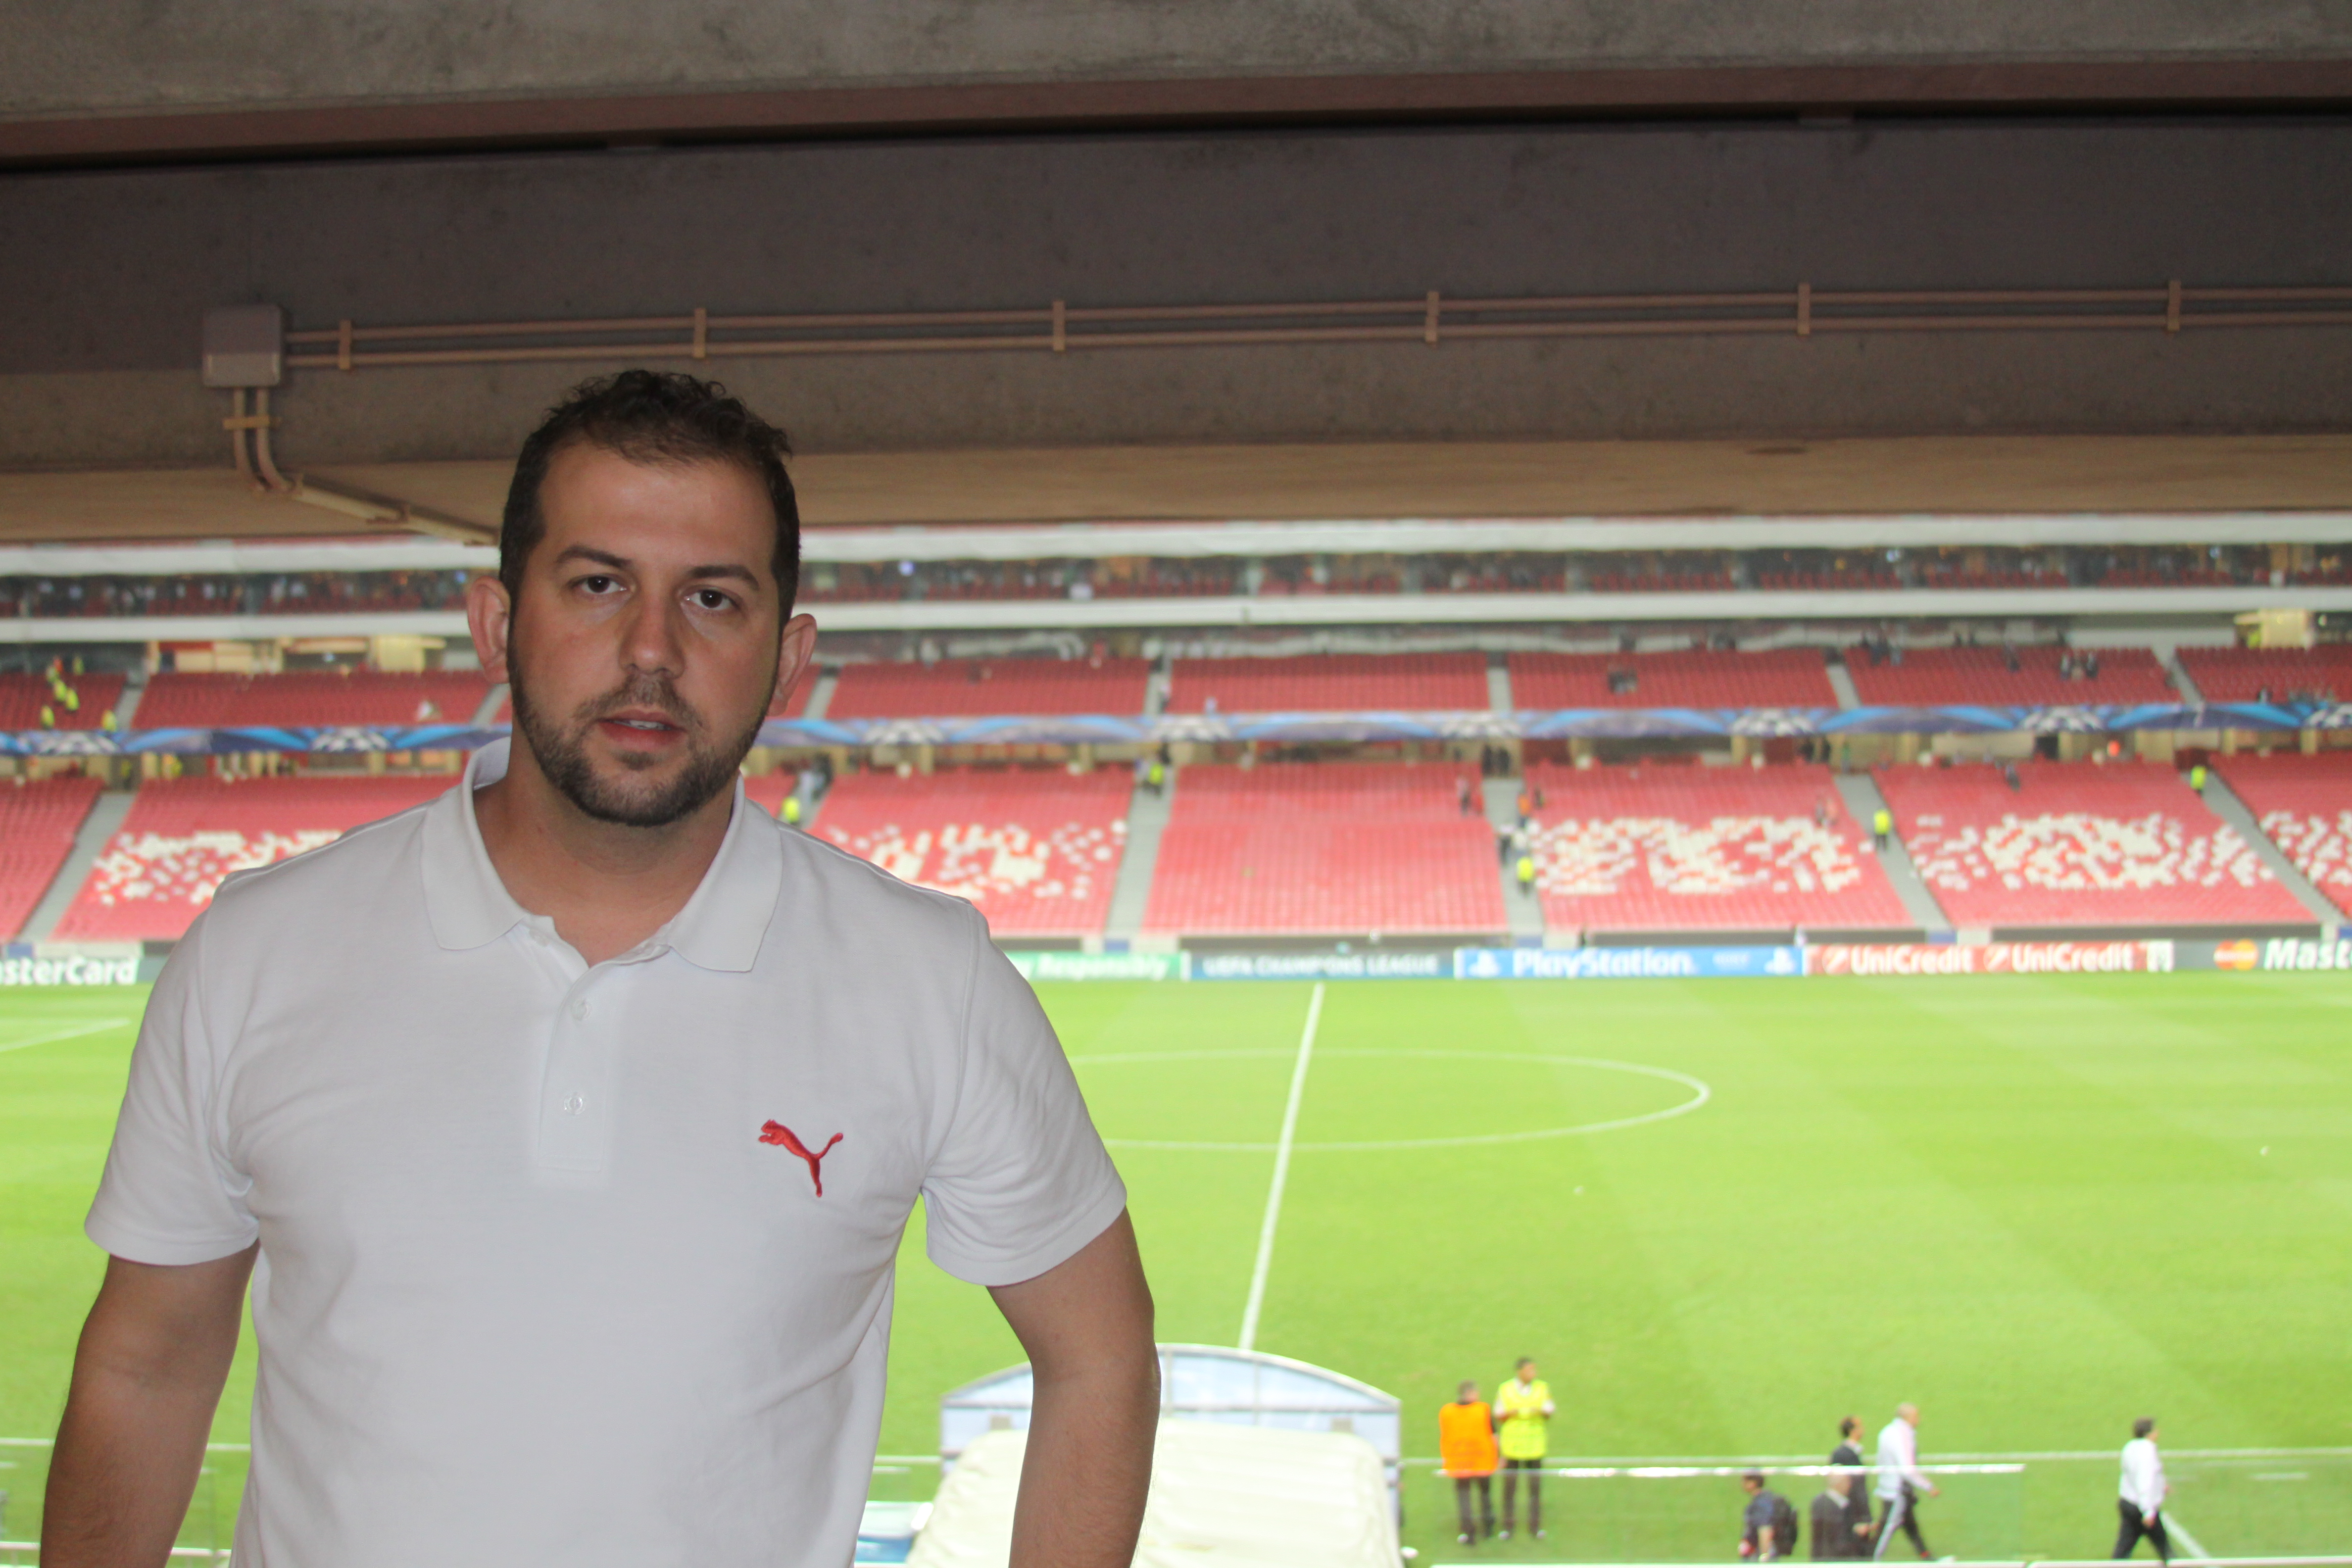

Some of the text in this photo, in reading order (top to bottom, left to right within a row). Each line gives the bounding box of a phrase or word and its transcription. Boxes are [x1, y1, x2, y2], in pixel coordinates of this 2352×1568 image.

[0, 954, 139, 986] sterCard
[1512, 947, 1695, 980] PlayStation
[1851, 944, 1972, 975] UniCredit
[2011, 941, 2133, 973] UniCredit
[2263, 937, 2352, 971] Mast
